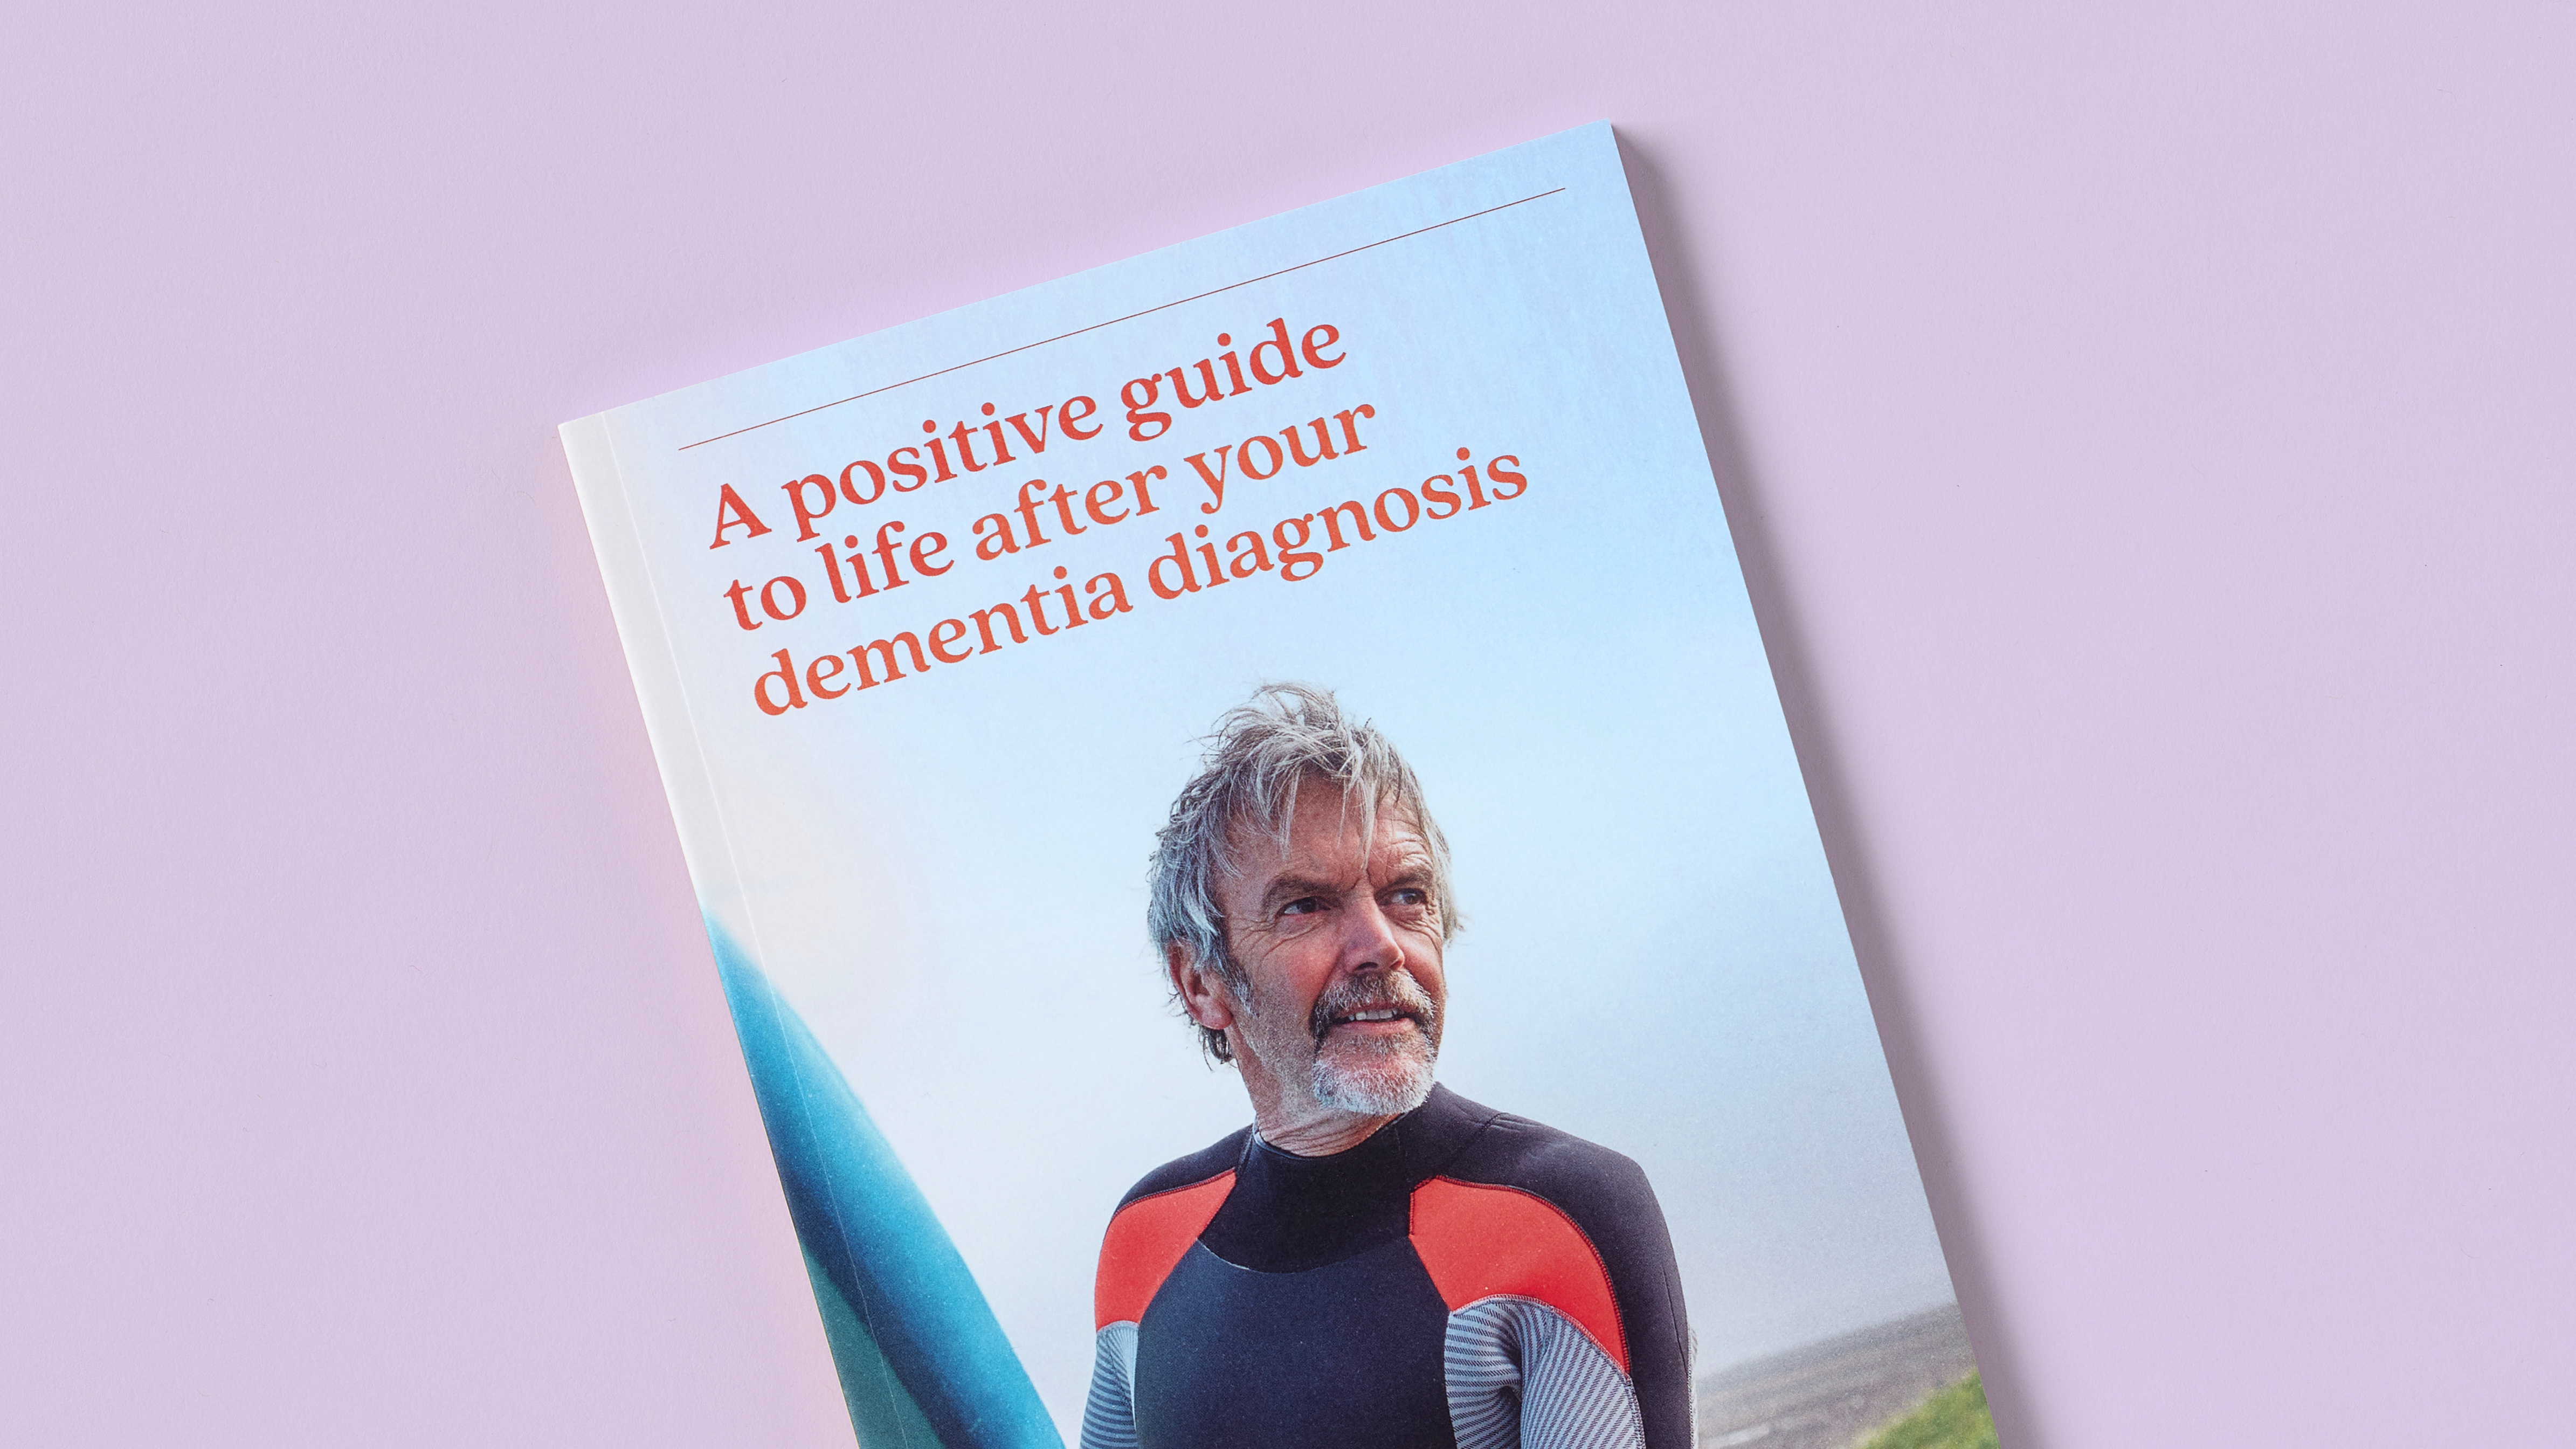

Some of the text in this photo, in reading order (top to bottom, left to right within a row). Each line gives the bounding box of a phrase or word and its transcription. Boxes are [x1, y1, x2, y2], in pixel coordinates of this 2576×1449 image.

[710, 318, 1346, 549] A positive guide
[723, 404, 1375, 631] to life after your
[754, 447, 1528, 716] dementia diagnosis
